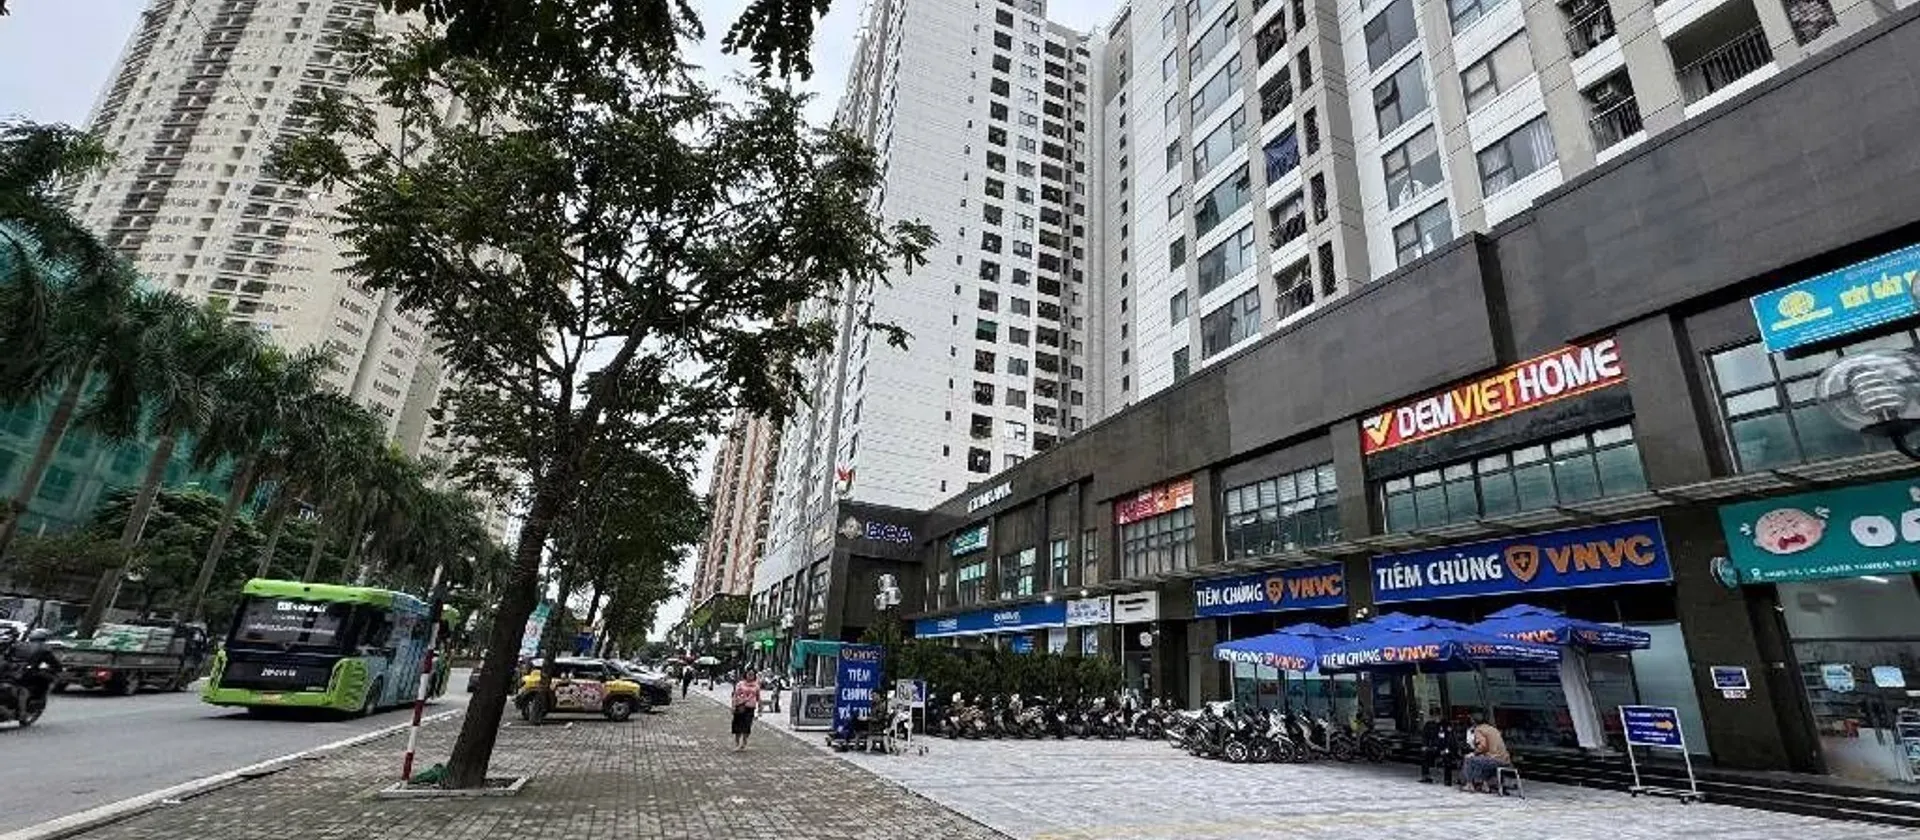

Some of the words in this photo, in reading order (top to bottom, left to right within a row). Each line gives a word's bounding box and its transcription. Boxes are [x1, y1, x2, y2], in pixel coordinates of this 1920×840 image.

[1545, 534, 1656, 574] VNVC
[1288, 573, 1342, 599] VNVC
[1398, 645, 1440, 661] VNVC
